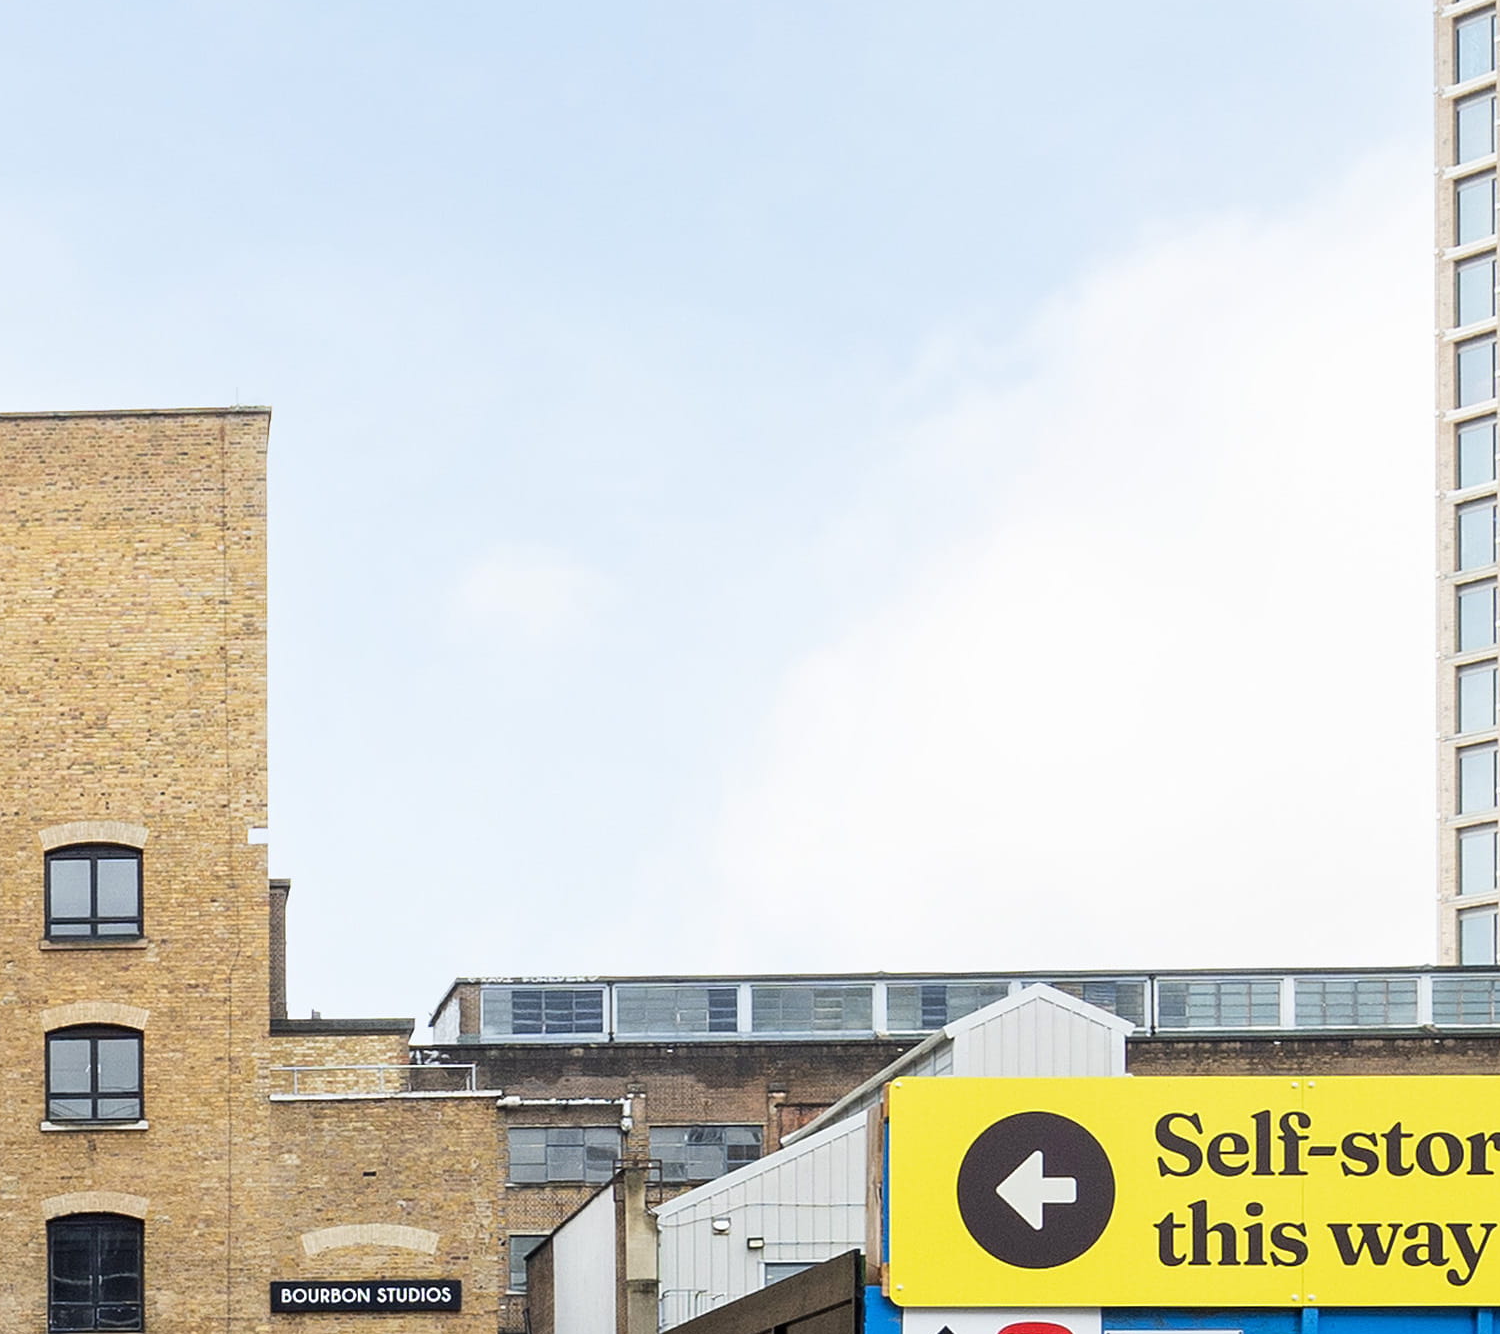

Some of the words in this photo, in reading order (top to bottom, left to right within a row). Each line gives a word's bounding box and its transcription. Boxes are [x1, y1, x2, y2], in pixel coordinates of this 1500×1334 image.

[1153, 1199, 1309, 1268] this
[1327, 1221, 1498, 1287] way
[281, 1287, 371, 1304] BOURBON
[376, 1286, 452, 1303] STUDIOS
